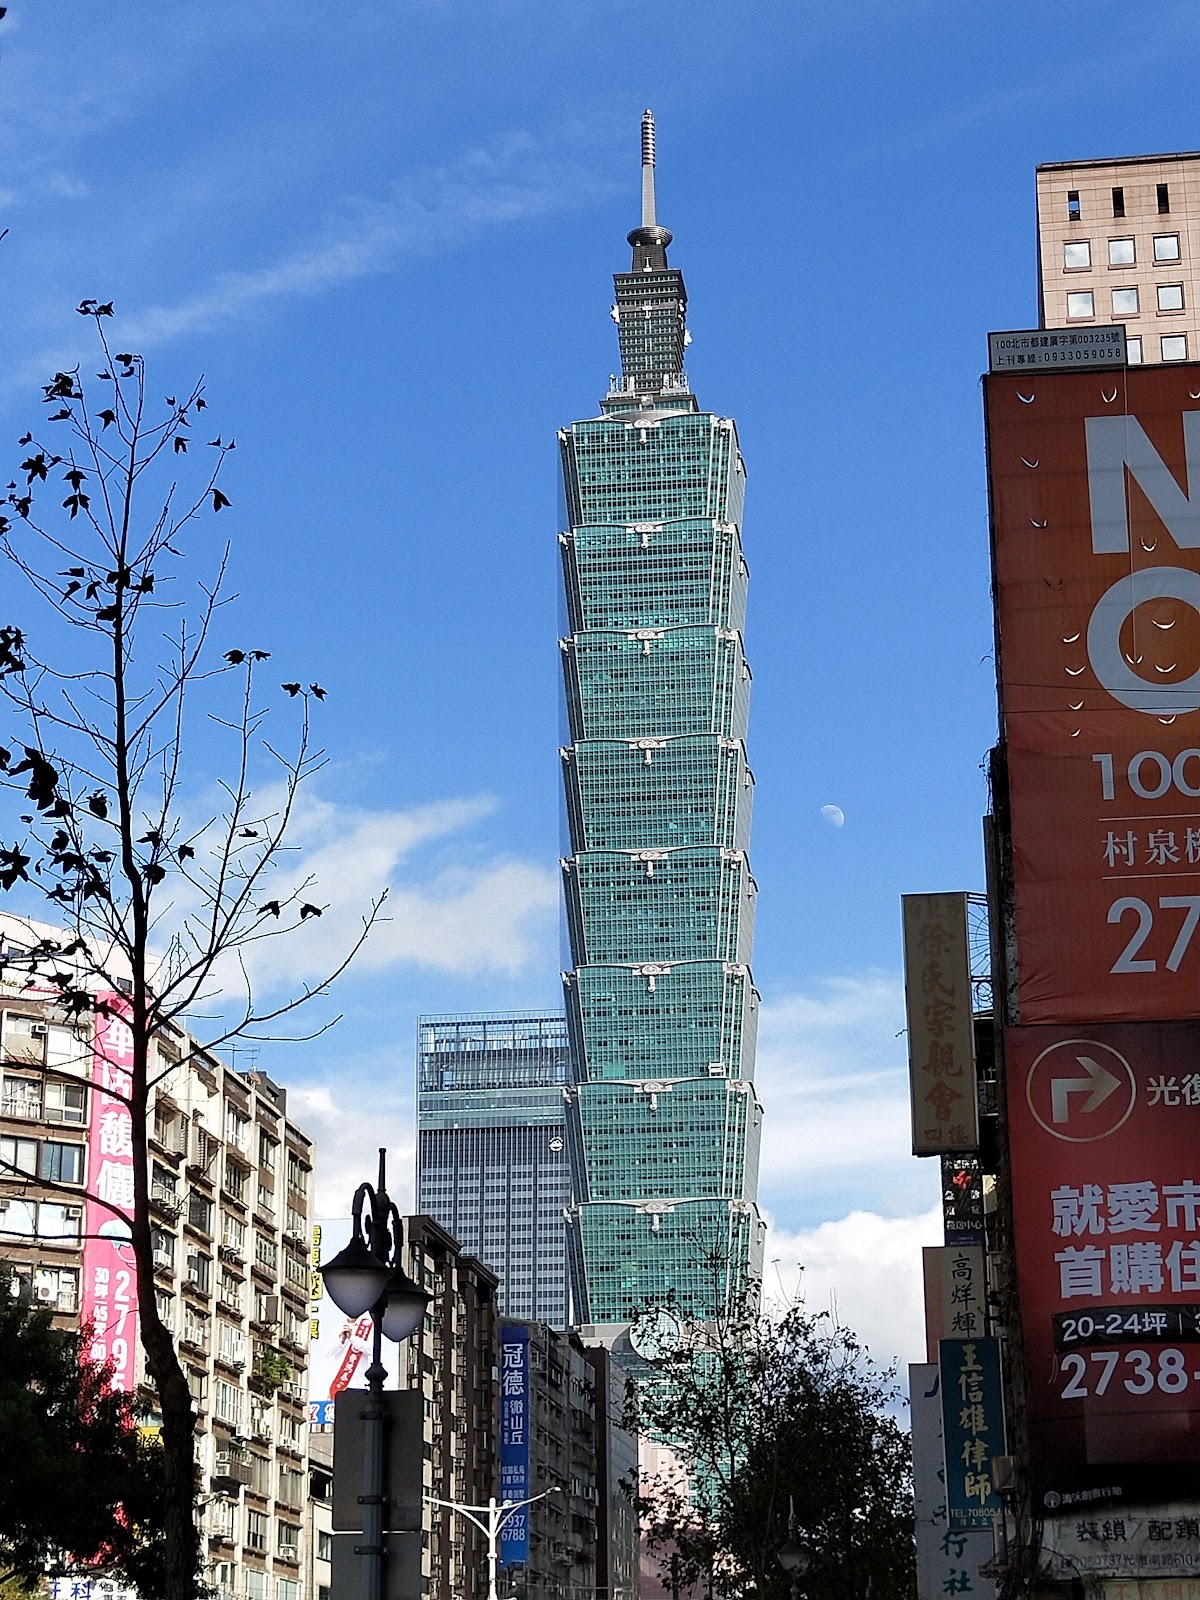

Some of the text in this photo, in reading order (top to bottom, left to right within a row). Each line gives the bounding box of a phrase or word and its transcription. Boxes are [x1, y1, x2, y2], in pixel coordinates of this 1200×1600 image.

[1106, 896, 1200, 974] 27
[1050, 1180, 1200, 1237] 就愛市
[1054, 1241, 1200, 1299] 首購住
[1061, 1311, 1168, 1342] 20-24坪
[502, 1343, 525, 1396] 冠德
[958, 1344, 992, 1505] 王信雄律師
[501, 1528, 525, 1542] 6788
